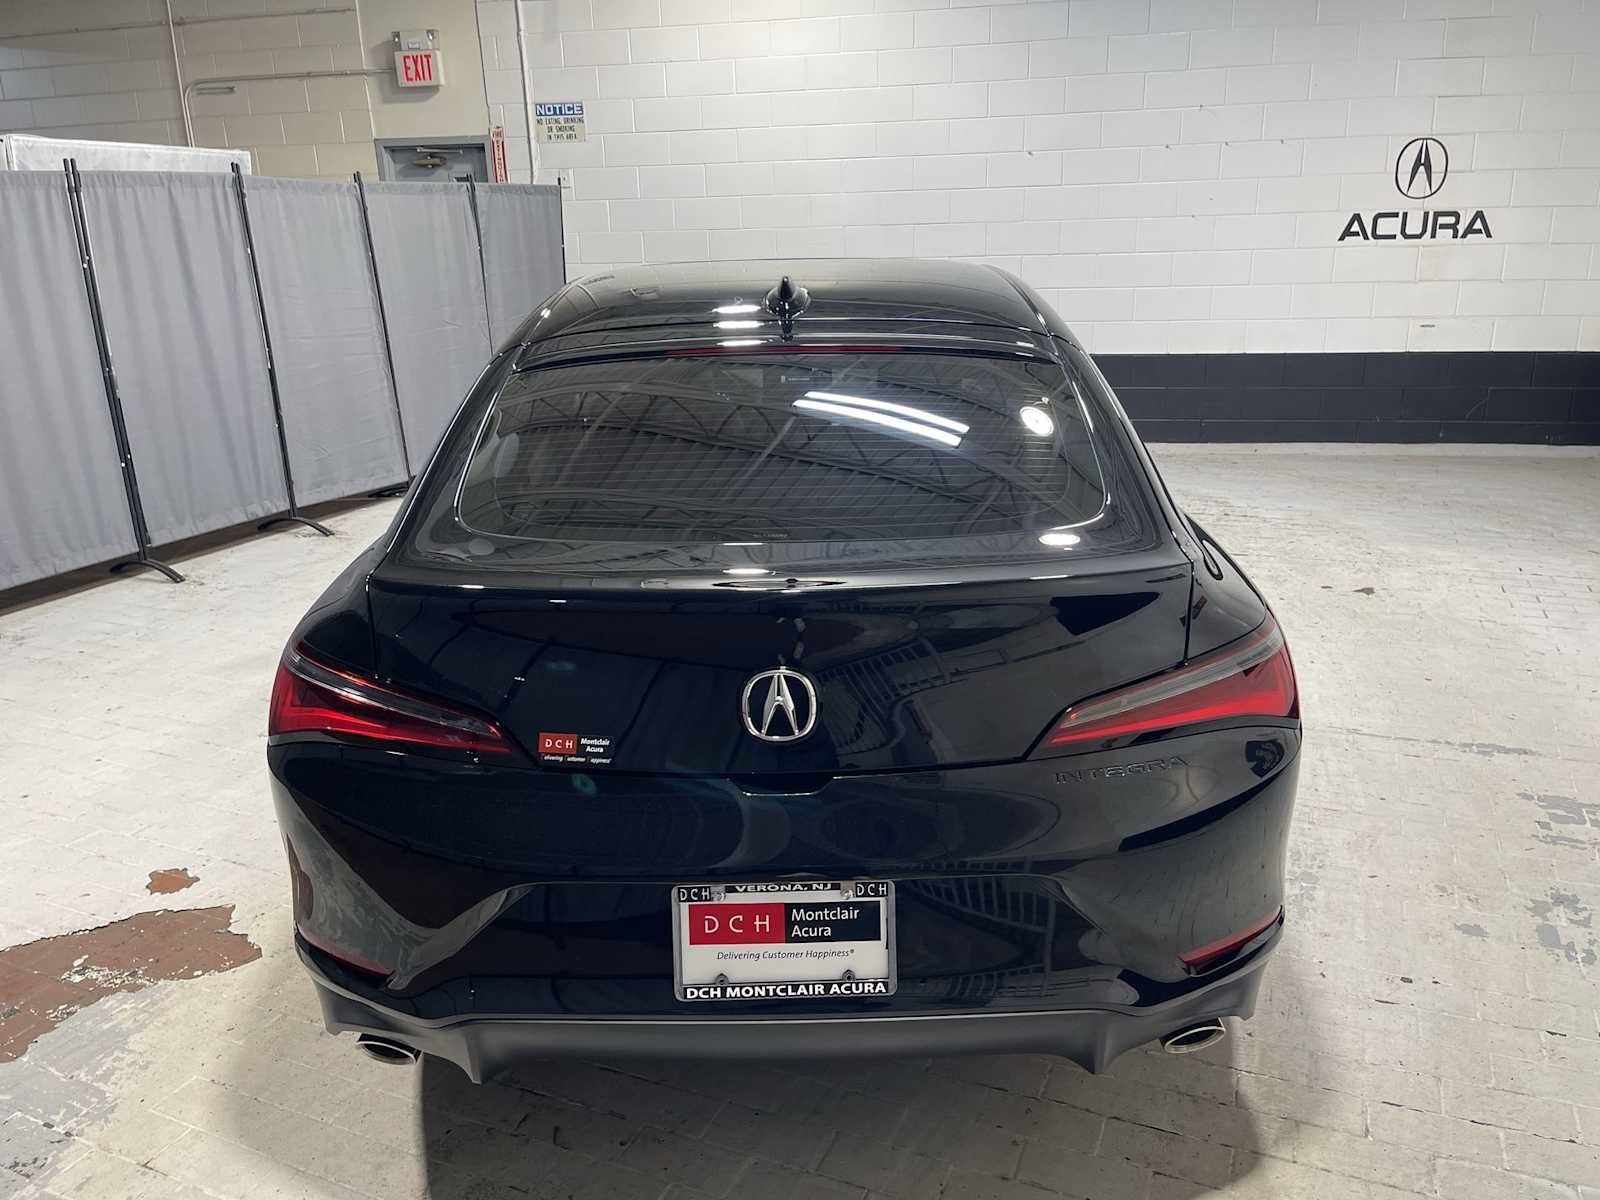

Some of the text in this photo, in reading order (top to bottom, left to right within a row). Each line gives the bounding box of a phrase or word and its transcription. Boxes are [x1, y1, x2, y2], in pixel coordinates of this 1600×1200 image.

[403, 54, 432, 82] EXIT
[536, 103, 583, 115] NOTICE
[547, 125, 553, 133] OR
[1337, 210, 1493, 241] ACURA
[545, 738, 573, 749] DCH
[580, 738, 610, 746] Montclair
[585, 745, 604, 753] Acura
[1055, 756, 1189, 784] INTEGRA
[813, 883, 833, 891] NJ
[856, 883, 887, 896] DCH
[679, 888, 711, 901] DCH
[791, 907, 860, 921] Montclair
[704, 914, 770, 934] DCH
[791, 924, 832, 938] Acura
[717, 951, 760, 961] Delivering
[762, 950, 804, 960] Customer
[686, 982, 886, 999] DCH MONTCLAIR ACURA
